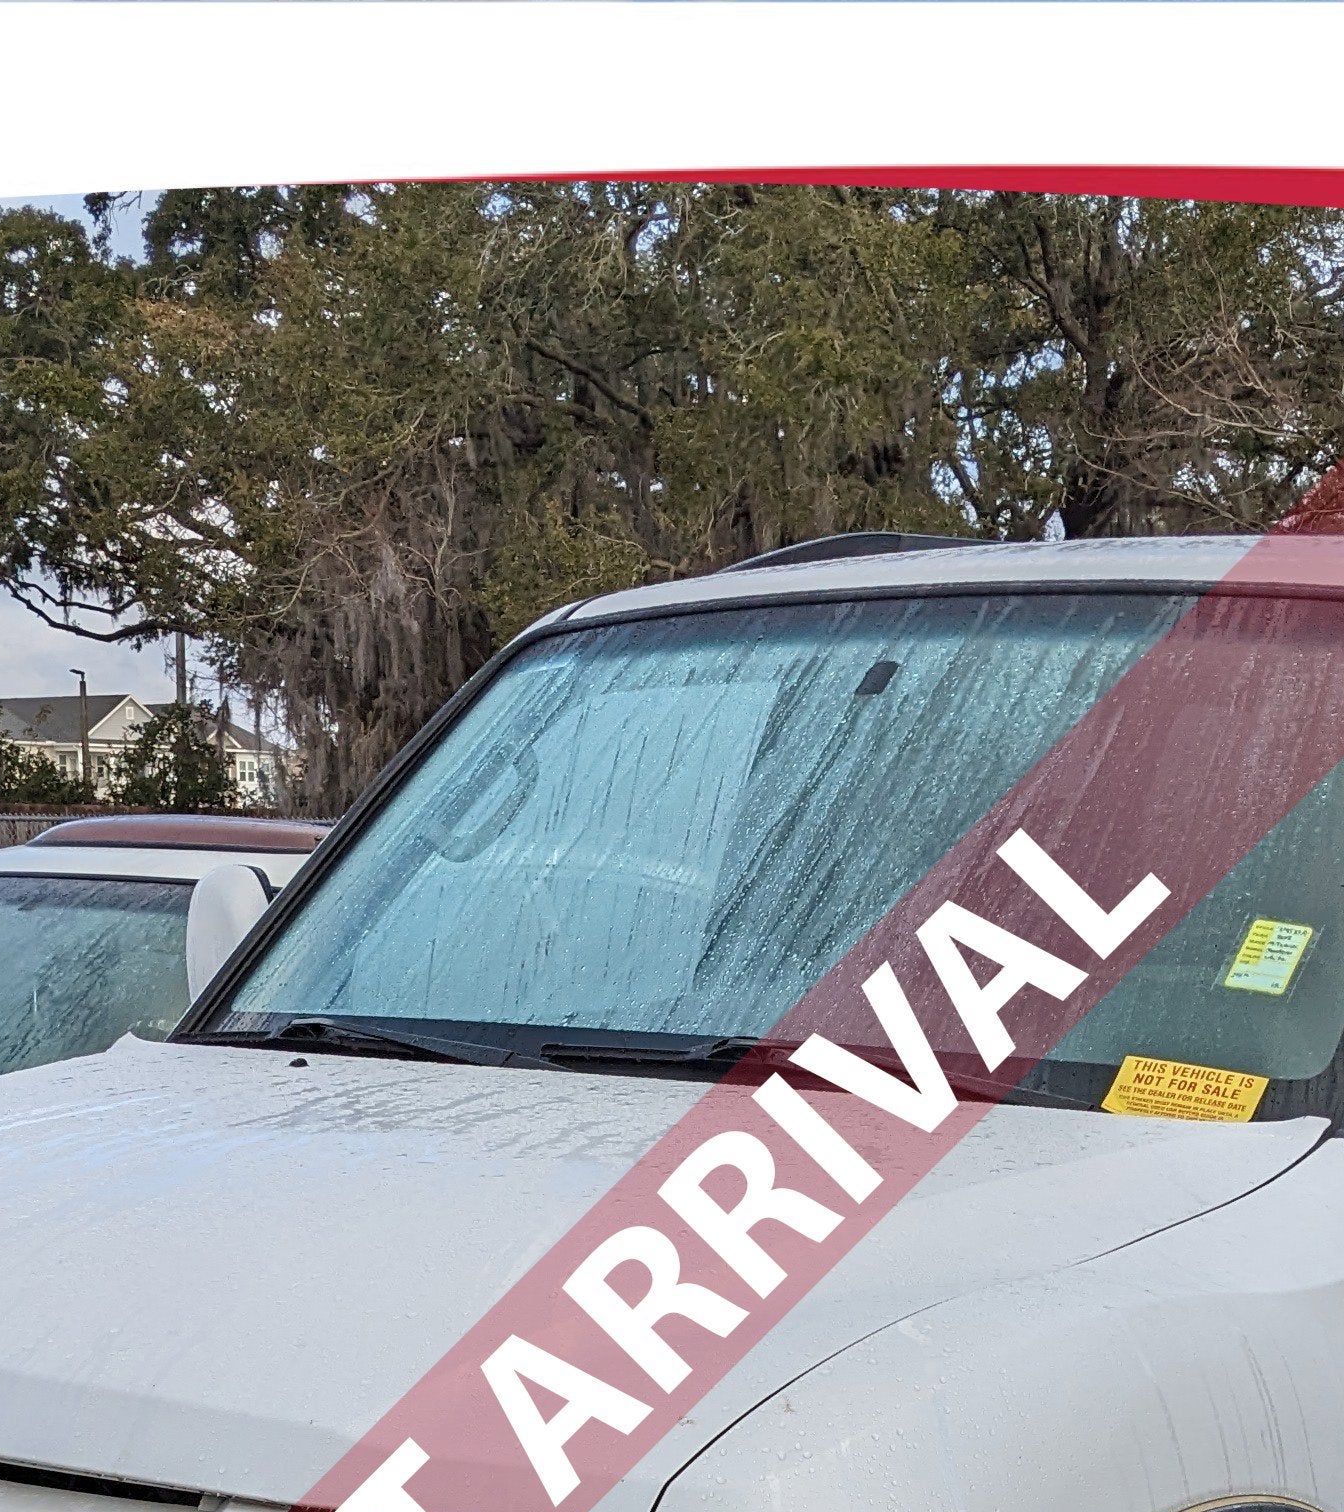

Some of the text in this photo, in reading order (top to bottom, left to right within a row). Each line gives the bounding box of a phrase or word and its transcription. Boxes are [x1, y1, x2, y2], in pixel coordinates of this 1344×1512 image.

[1133, 1073, 1242, 1100] NOT FOR SALE
[1134, 1060, 1255, 1089] THIS VEHICLE IS
[1118, 1085, 1247, 1112] SEE THE DEALER FOR RELEASE DATE
